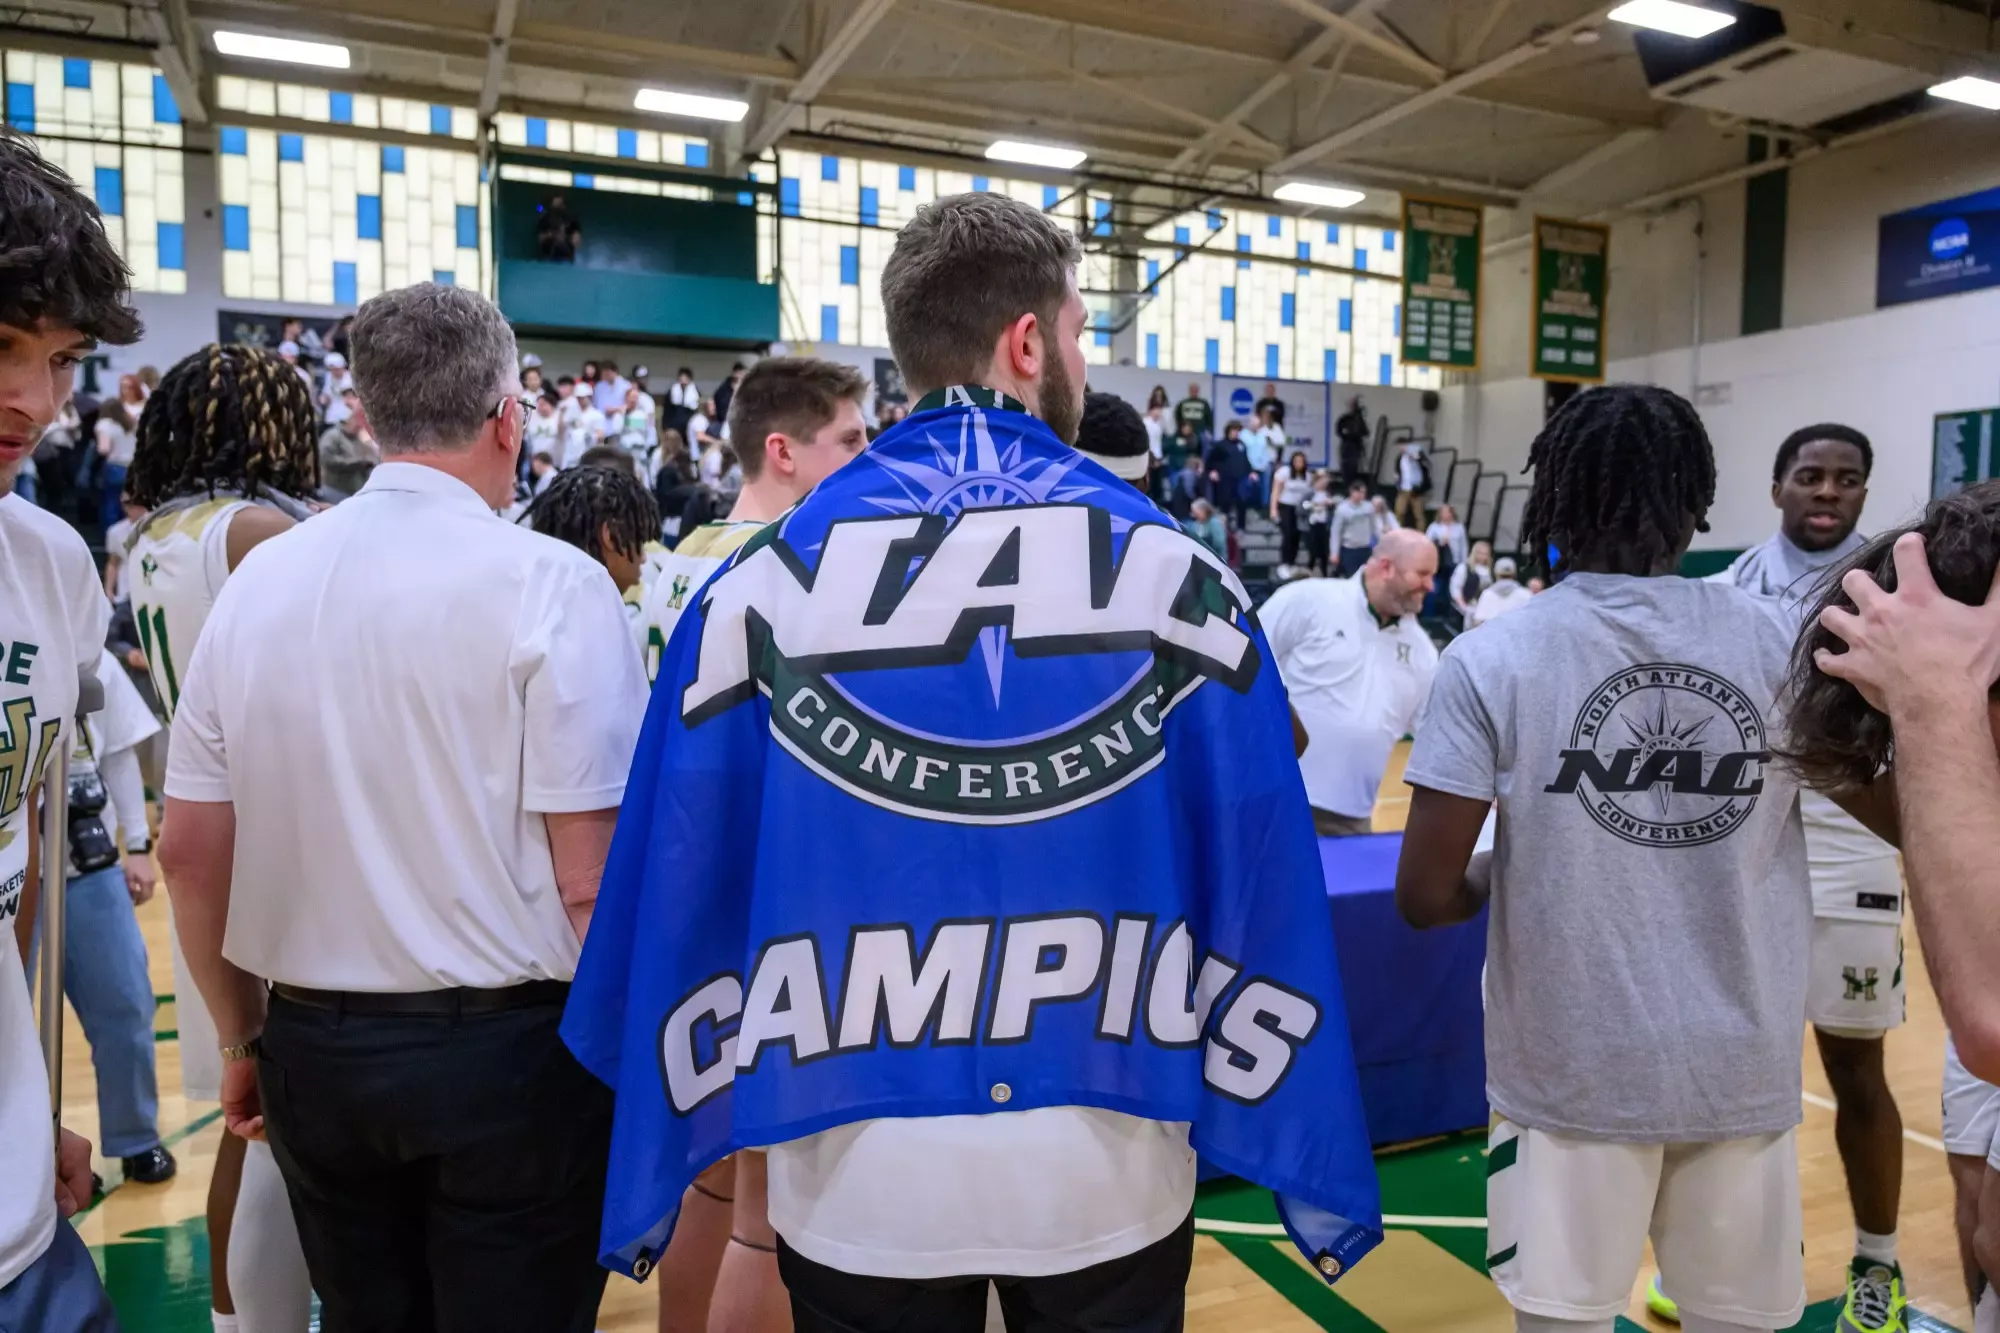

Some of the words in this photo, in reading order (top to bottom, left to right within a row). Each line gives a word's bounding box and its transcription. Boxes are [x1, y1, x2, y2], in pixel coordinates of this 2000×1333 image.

[1581, 674, 1641, 739] NORTH
[1650, 671, 1758, 739] ATLANTIC
[786, 686, 1165, 799] CONFERENC
[1543, 748, 1773, 796] NAC
[1597, 800, 1742, 840] CONFERENCE
